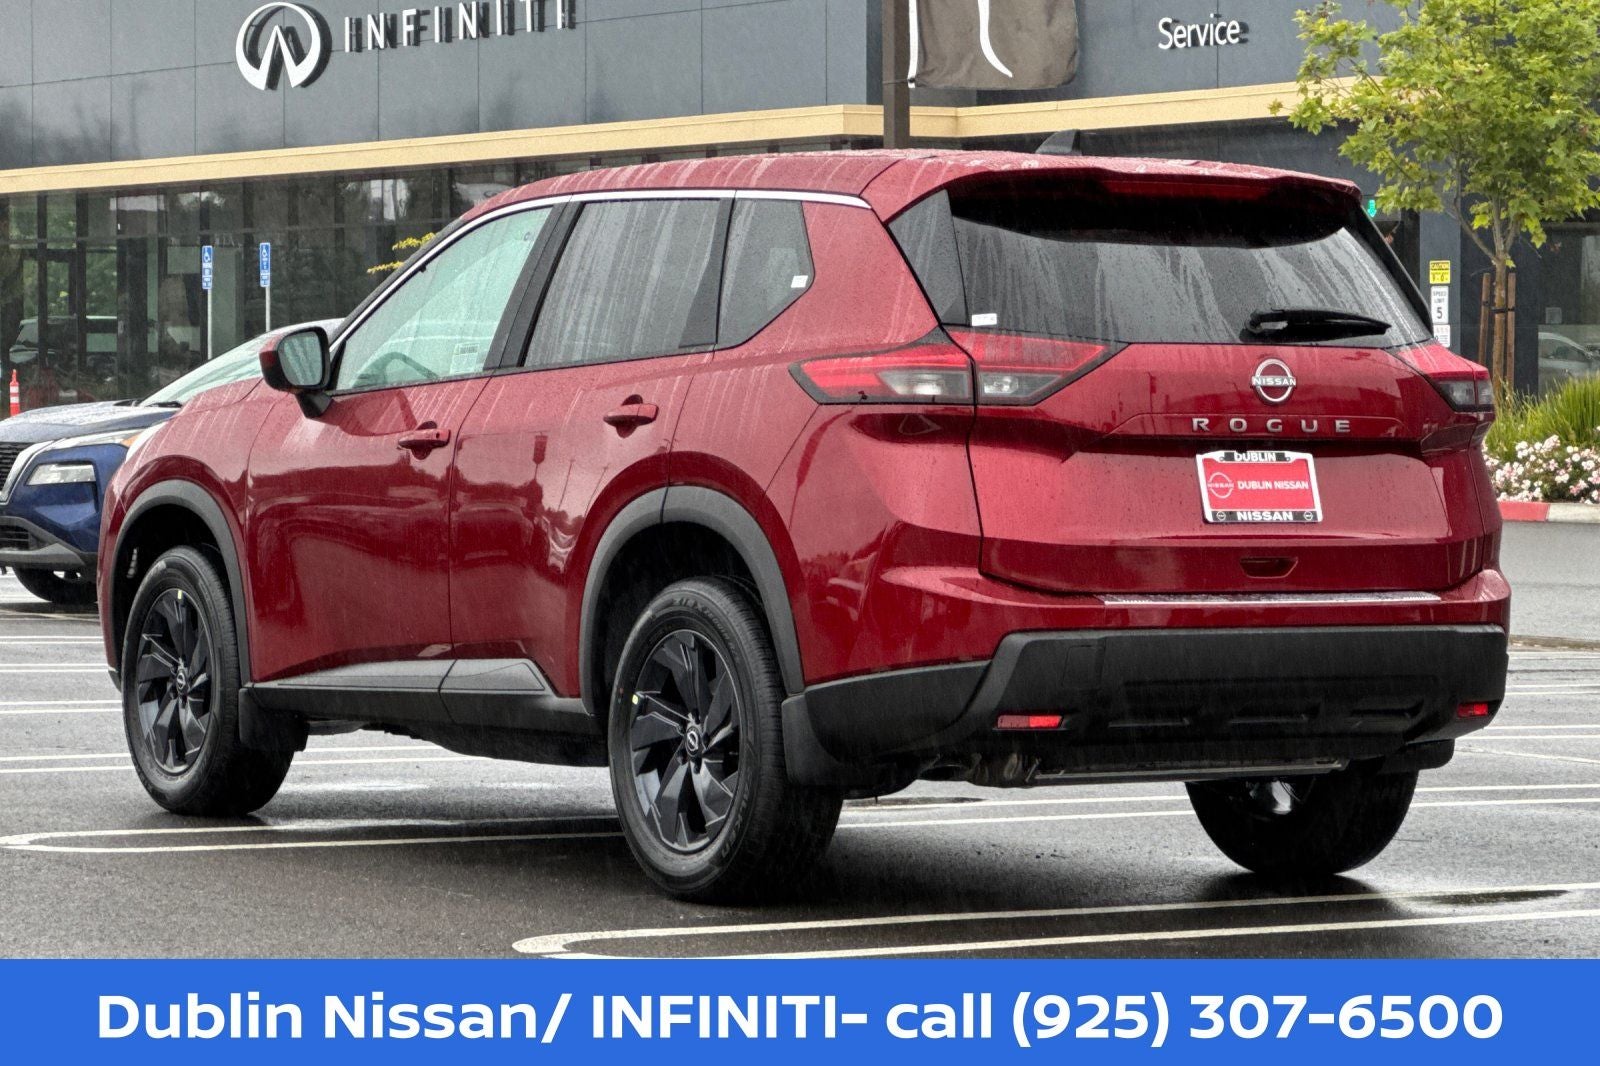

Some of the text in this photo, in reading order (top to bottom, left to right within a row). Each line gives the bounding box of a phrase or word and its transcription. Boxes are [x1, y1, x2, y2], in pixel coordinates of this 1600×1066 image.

[1158, 13, 1241, 49] Service
[1436, 306, 1443, 319] 5
[1253, 377, 1296, 386] NISSAN
[1191, 417, 1351, 433] ROGUE
[1234, 452, 1276, 462] DUBLIN
[1237, 481, 1309, 489] DUBLIN NISSAN
[1236, 511, 1293, 521] NISSAN
